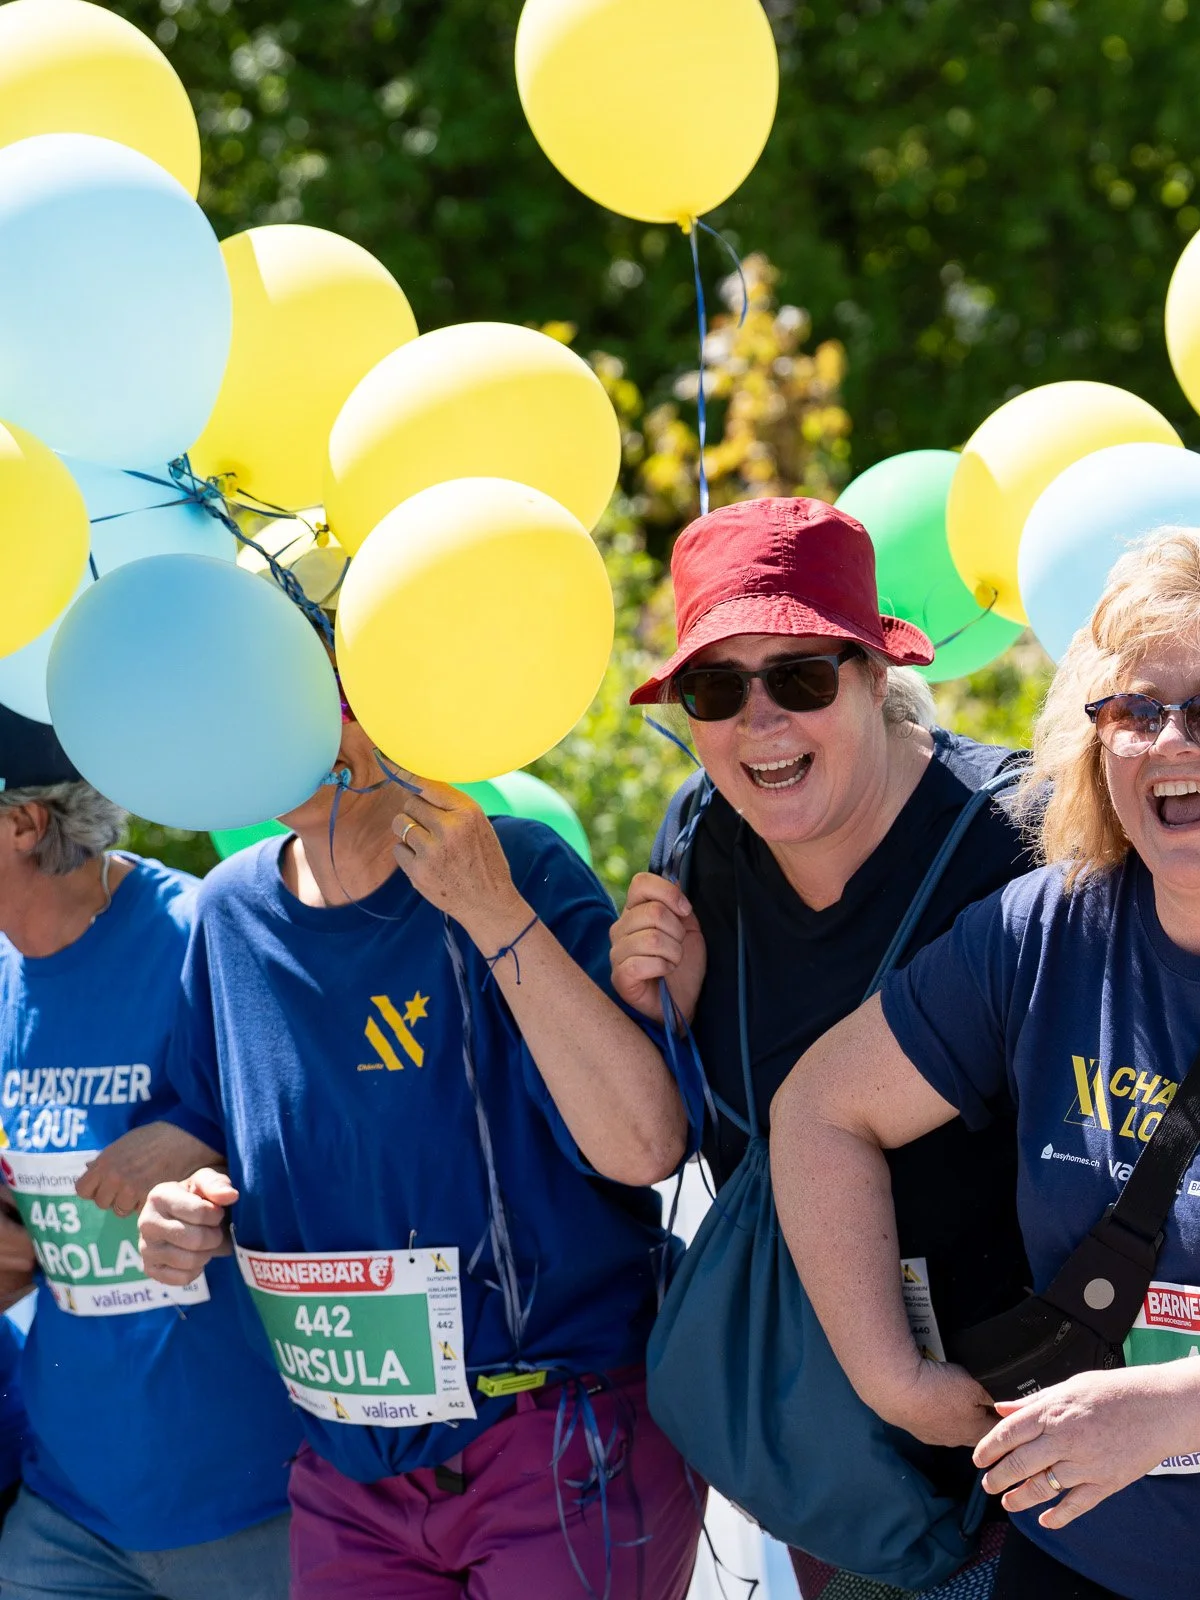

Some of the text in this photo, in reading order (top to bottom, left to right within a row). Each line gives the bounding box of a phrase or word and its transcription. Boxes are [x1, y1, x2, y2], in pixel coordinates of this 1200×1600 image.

[3, 1063, 152, 1109] CHÄSITZER
[17, 1108, 88, 1149] LOUF
[1118, 1106, 1163, 1143] LO
[1053, 1152, 1100, 1168] easyhomes.ch
[30, 1201, 82, 1234] 443
[251, 1259, 366, 1284] BÄRNERBÄR
[92, 1287, 154, 1308] valiant
[294, 1304, 353, 1338] 442
[436, 1320, 454, 1330] 442
[274, 1338, 411, 1387] URSULA
[362, 1402, 419, 1420] valiant
